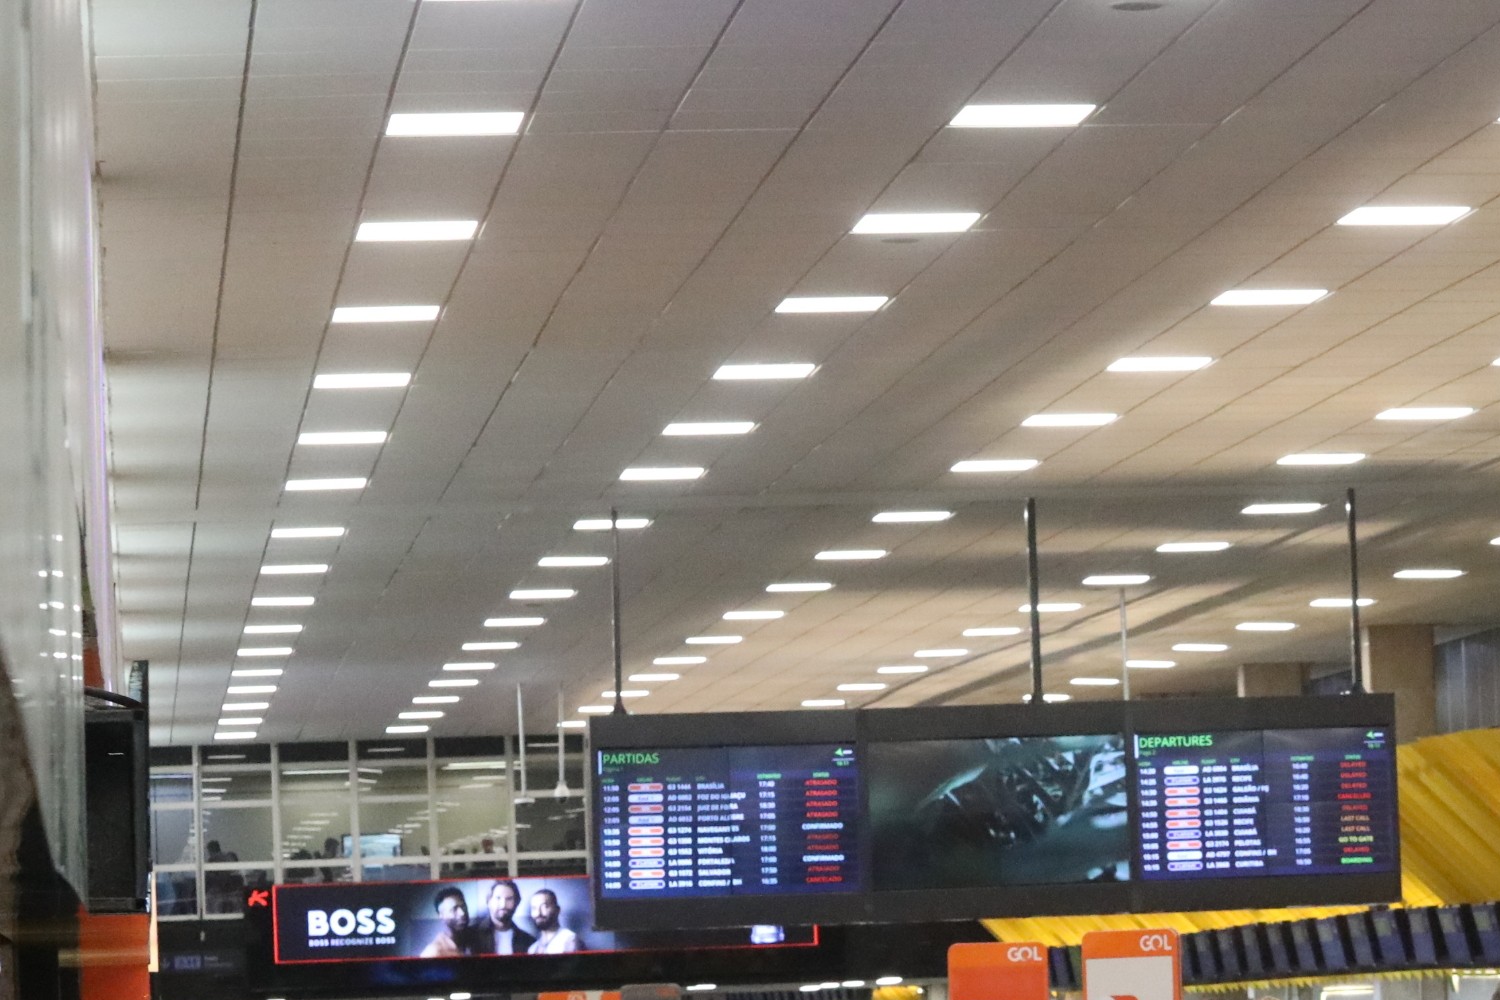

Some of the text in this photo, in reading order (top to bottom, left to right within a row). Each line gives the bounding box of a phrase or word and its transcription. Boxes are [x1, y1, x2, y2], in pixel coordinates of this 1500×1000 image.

[1140, 735, 1213, 748] DEPARTURES
[603, 753, 659, 764] PARTIDAS
[308, 907, 395, 936] BOSS
[308, 937, 396, 947] BOSS RECOGNIZE BOSS
[1139, 934, 1172, 951] GOL
[1007, 946, 1042, 962] GOL
